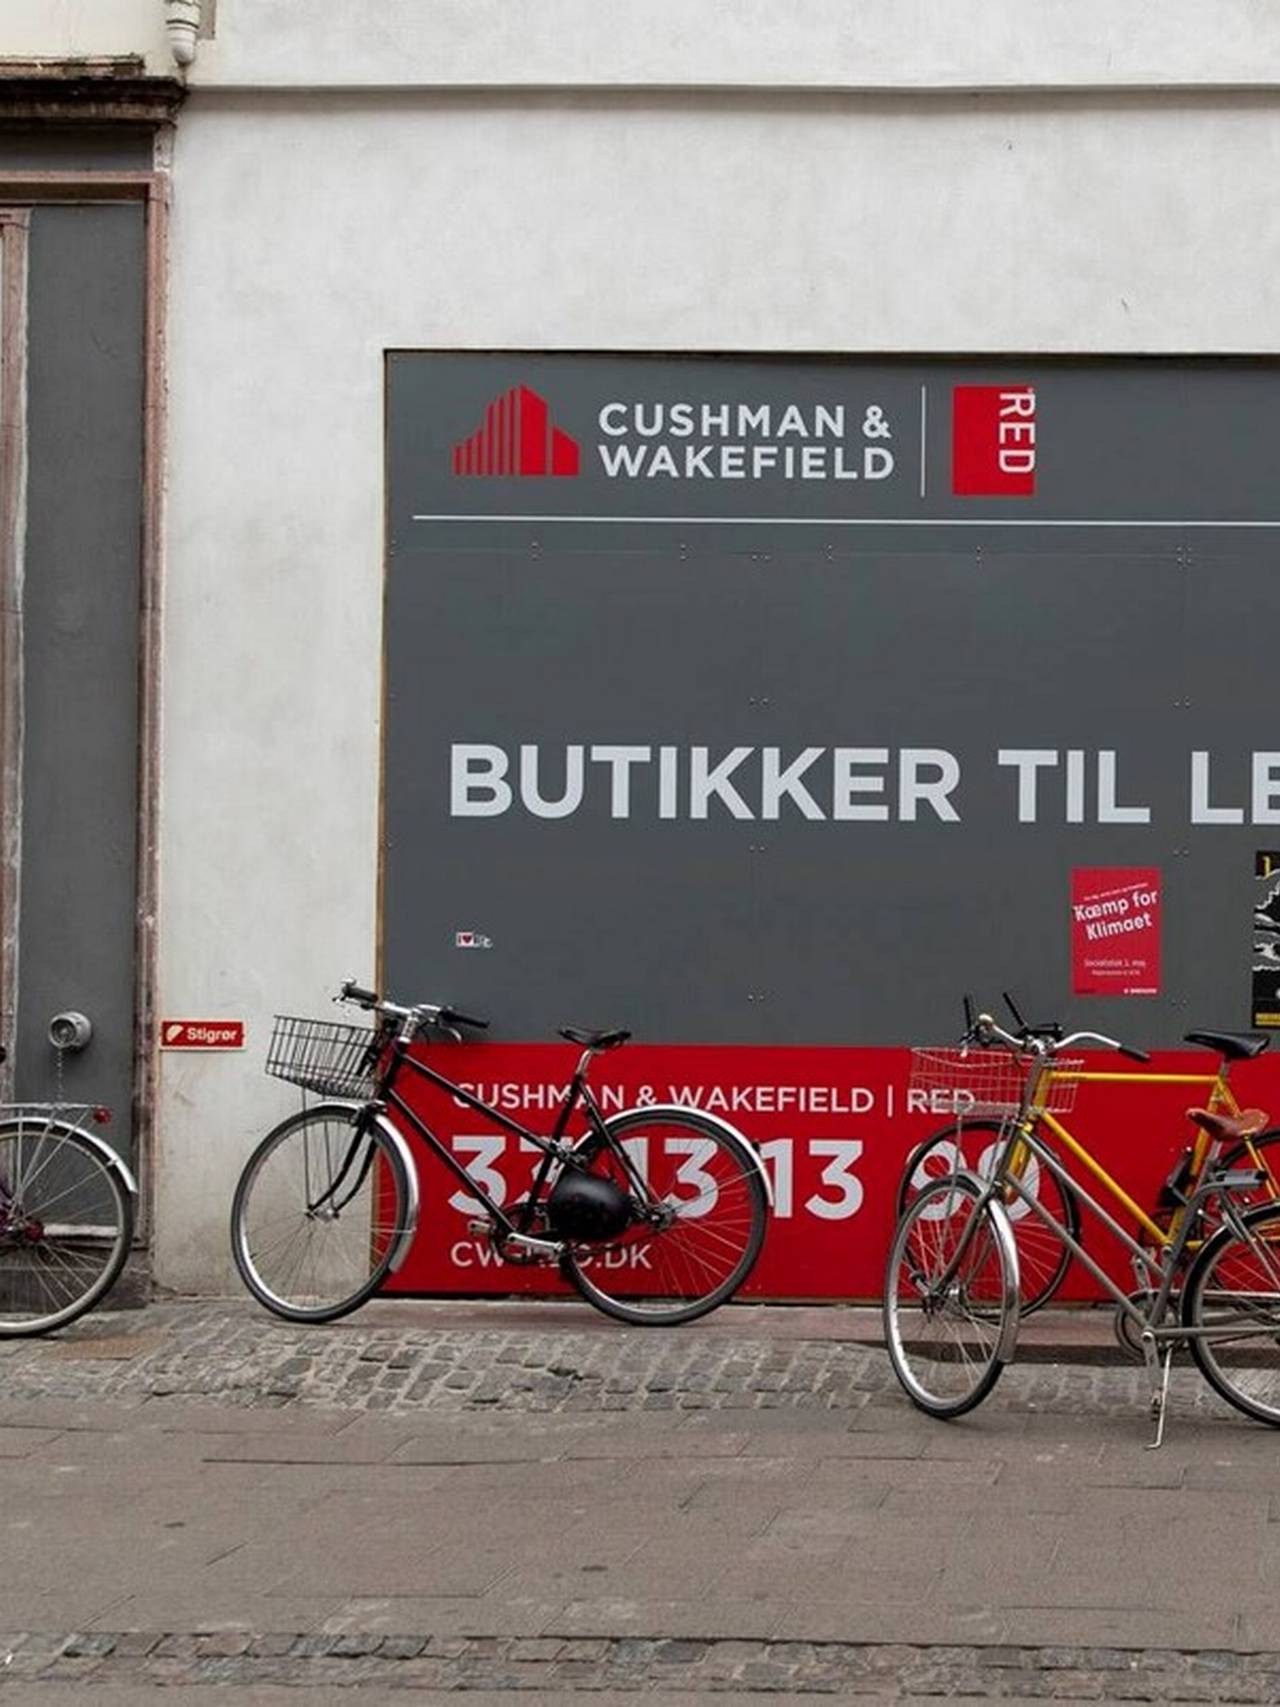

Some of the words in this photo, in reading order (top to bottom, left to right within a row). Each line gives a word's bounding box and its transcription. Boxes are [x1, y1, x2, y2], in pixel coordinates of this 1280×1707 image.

[599, 402, 844, 437] CUSHMAN
[861, 405, 892, 438] &
[999, 393, 1036, 473] RED
[598, 445, 894, 479] WAKEFIELD
[450, 744, 959, 821] BUTIKKER
[998, 749, 1150, 823] TIL
[1132, 891, 1157, 907] for
[1086, 913, 1152, 940] Klimaet
[669, 1086, 874, 1112] WAKEFIELD
[907, 1088, 975, 1114] RED
[759, 1138, 864, 1219] 13
